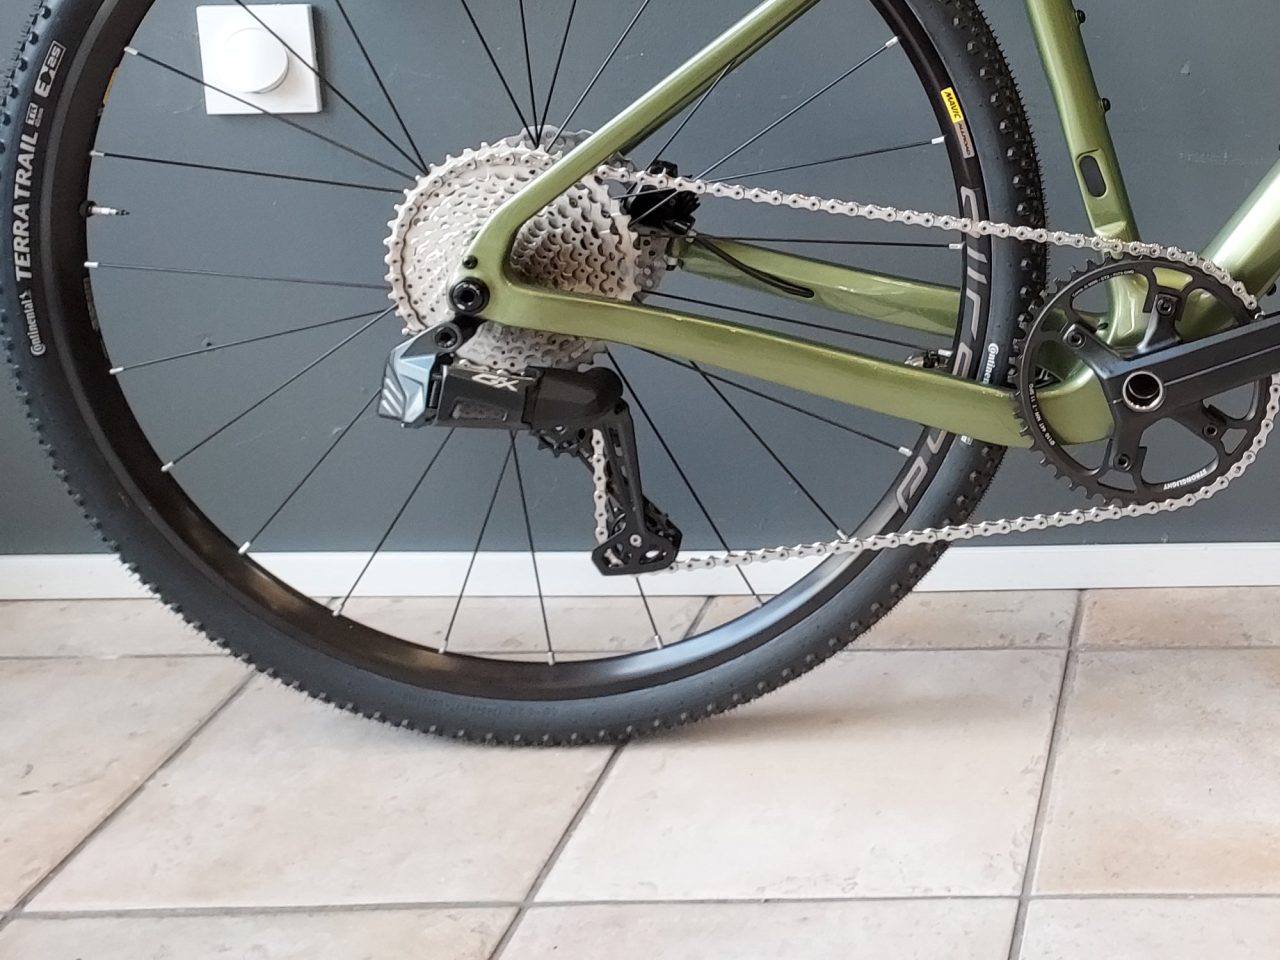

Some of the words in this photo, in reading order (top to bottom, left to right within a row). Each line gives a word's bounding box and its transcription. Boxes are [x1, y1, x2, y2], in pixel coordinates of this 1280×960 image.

[942, 90, 961, 120] MAVIC
[14, 132, 39, 200] TRAIL
[13, 202, 33, 282] TERRA
[21, 296, 47, 358] Continental
[471, 372, 520, 393] GX
[1163, 467, 1208, 492] STRONGLIGHT
